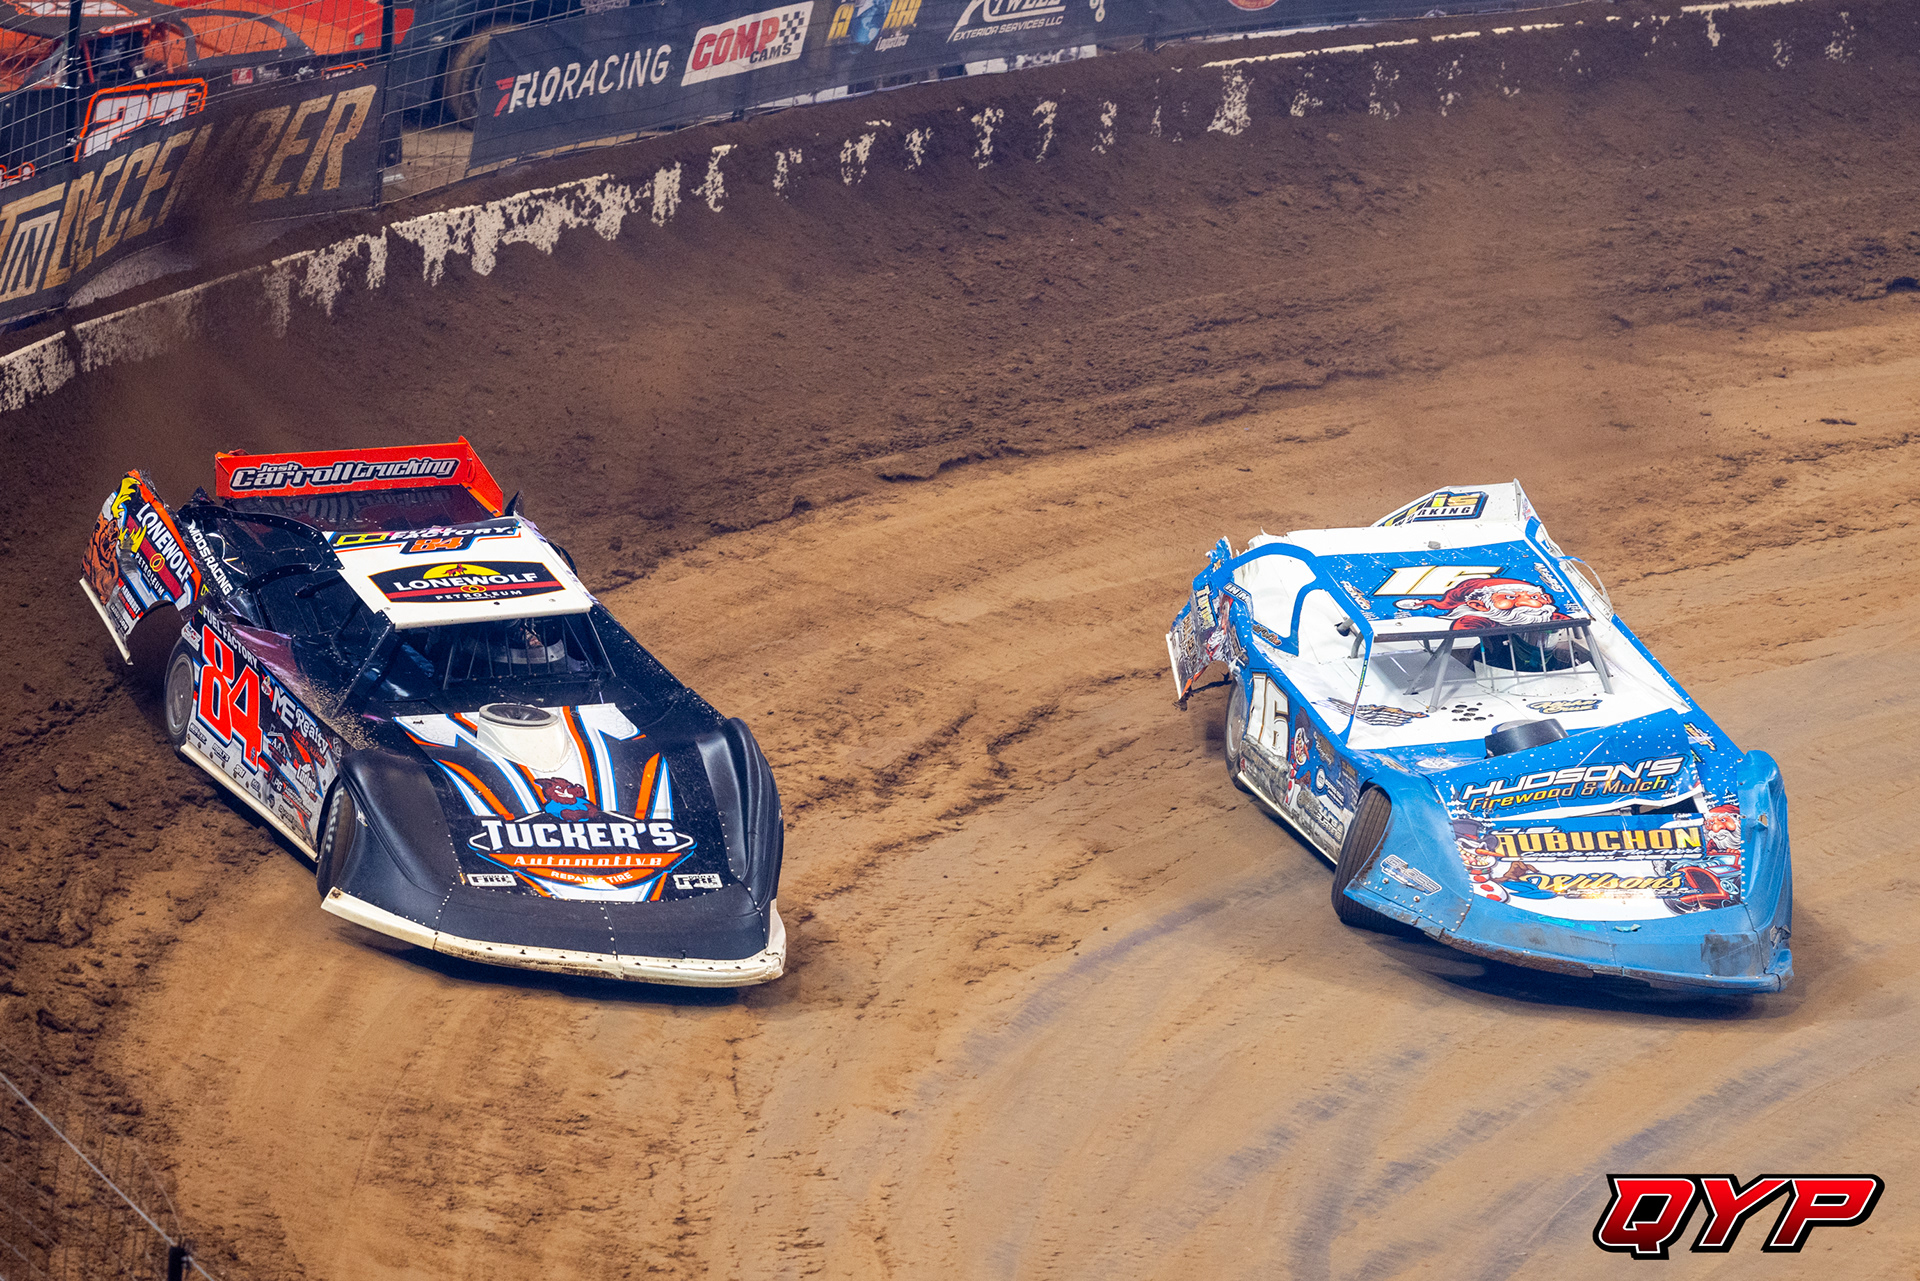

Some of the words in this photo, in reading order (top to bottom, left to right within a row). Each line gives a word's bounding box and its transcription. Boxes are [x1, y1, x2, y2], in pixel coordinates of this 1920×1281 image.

[692, 16, 781, 71] COMP
[953, 25, 999, 42] EXTERIOR
[999, 19, 1044, 33] SERVICES
[1045, 15, 1064, 27] LLC
[750, 42, 792, 64] CAMS
[258, 463, 299, 473] Josh
[136, 502, 193, 584] LONEWOLF
[410, 536, 463, 552] 84
[135, 552, 165, 596] PETROLEUM
[393, 572, 539, 591] LONEWOLF
[435, 589, 522, 601] PETROLEUM
[202, 605, 222, 632] FUEL
[221, 624, 258, 670] FACTORY
[198, 624, 262, 772] 84
[1248, 672, 1290, 757] 16
[295, 708, 329, 755] Realty
[1462, 757, 1684, 801] HUDSON'S
[1469, 783, 1577, 811] Firewood
[1580, 781, 1597, 796] &
[1603, 776, 1667, 795] Mulch
[481, 820, 678, 850] TUCKER'S
[1496, 827, 1702, 857] AUBUCHON
[514, 855, 662, 867] Automotive
[1585, 849, 1617, 858] and
[550, 871, 594, 884] REPAIR
[606, 872, 633, 884] TIRE
[1518, 871, 1686, 892] Wilson's
